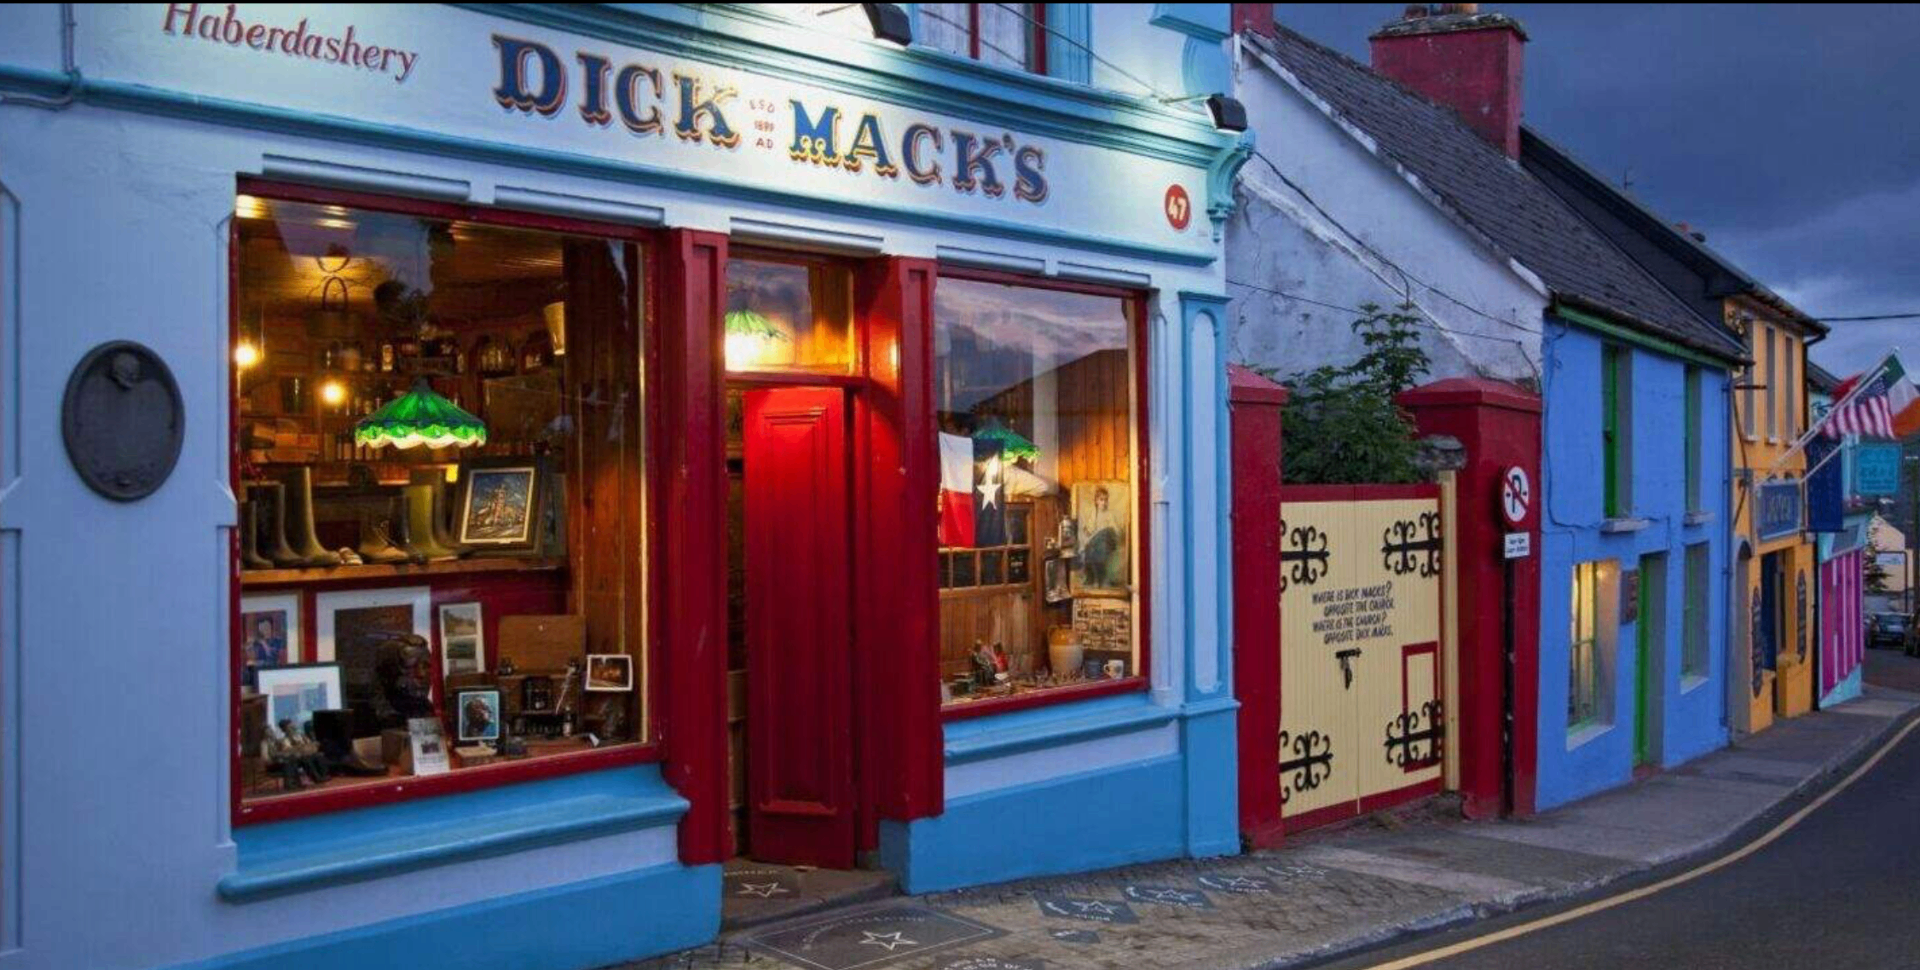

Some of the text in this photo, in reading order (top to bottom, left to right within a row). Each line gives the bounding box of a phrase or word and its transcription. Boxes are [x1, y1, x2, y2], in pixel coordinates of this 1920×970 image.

[163, 3, 419, 82] Haberdashery
[491, 33, 1049, 204] DICK MACK'S
[1168, 195, 1188, 221] 47
[1336, 589, 1344, 601] IS
[1355, 600, 1367, 612] THE
